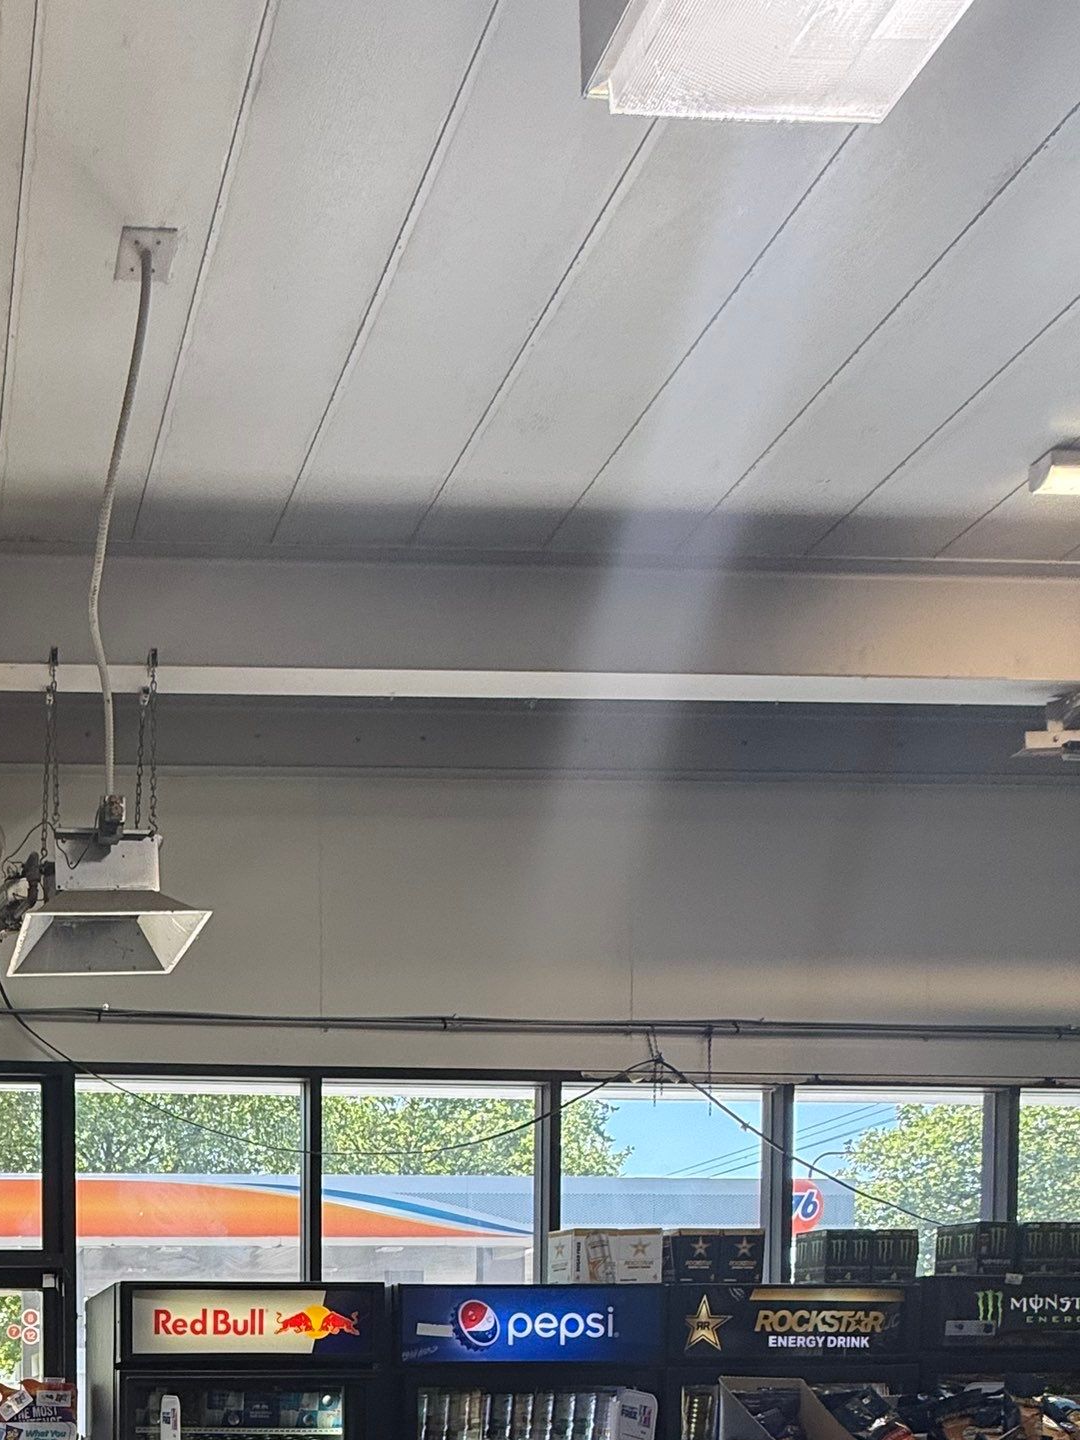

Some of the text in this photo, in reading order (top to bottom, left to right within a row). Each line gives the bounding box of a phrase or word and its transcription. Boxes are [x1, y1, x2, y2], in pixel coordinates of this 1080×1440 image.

[792, 1190, 819, 1220] 76
[1010, 1294, 1080, 1313] MONST
[154, 1309, 264, 1335] Red Bull
[508, 1306, 615, 1346] pepsi
[754, 1310, 886, 1333] ROCKSTAR
[25, 1332, 36, 1340] 12
[768, 1336, 870, 1348] ENERGY DRINK
[30, 1405, 58, 1418] MOST
[25, 1429, 67, 1438] What You
